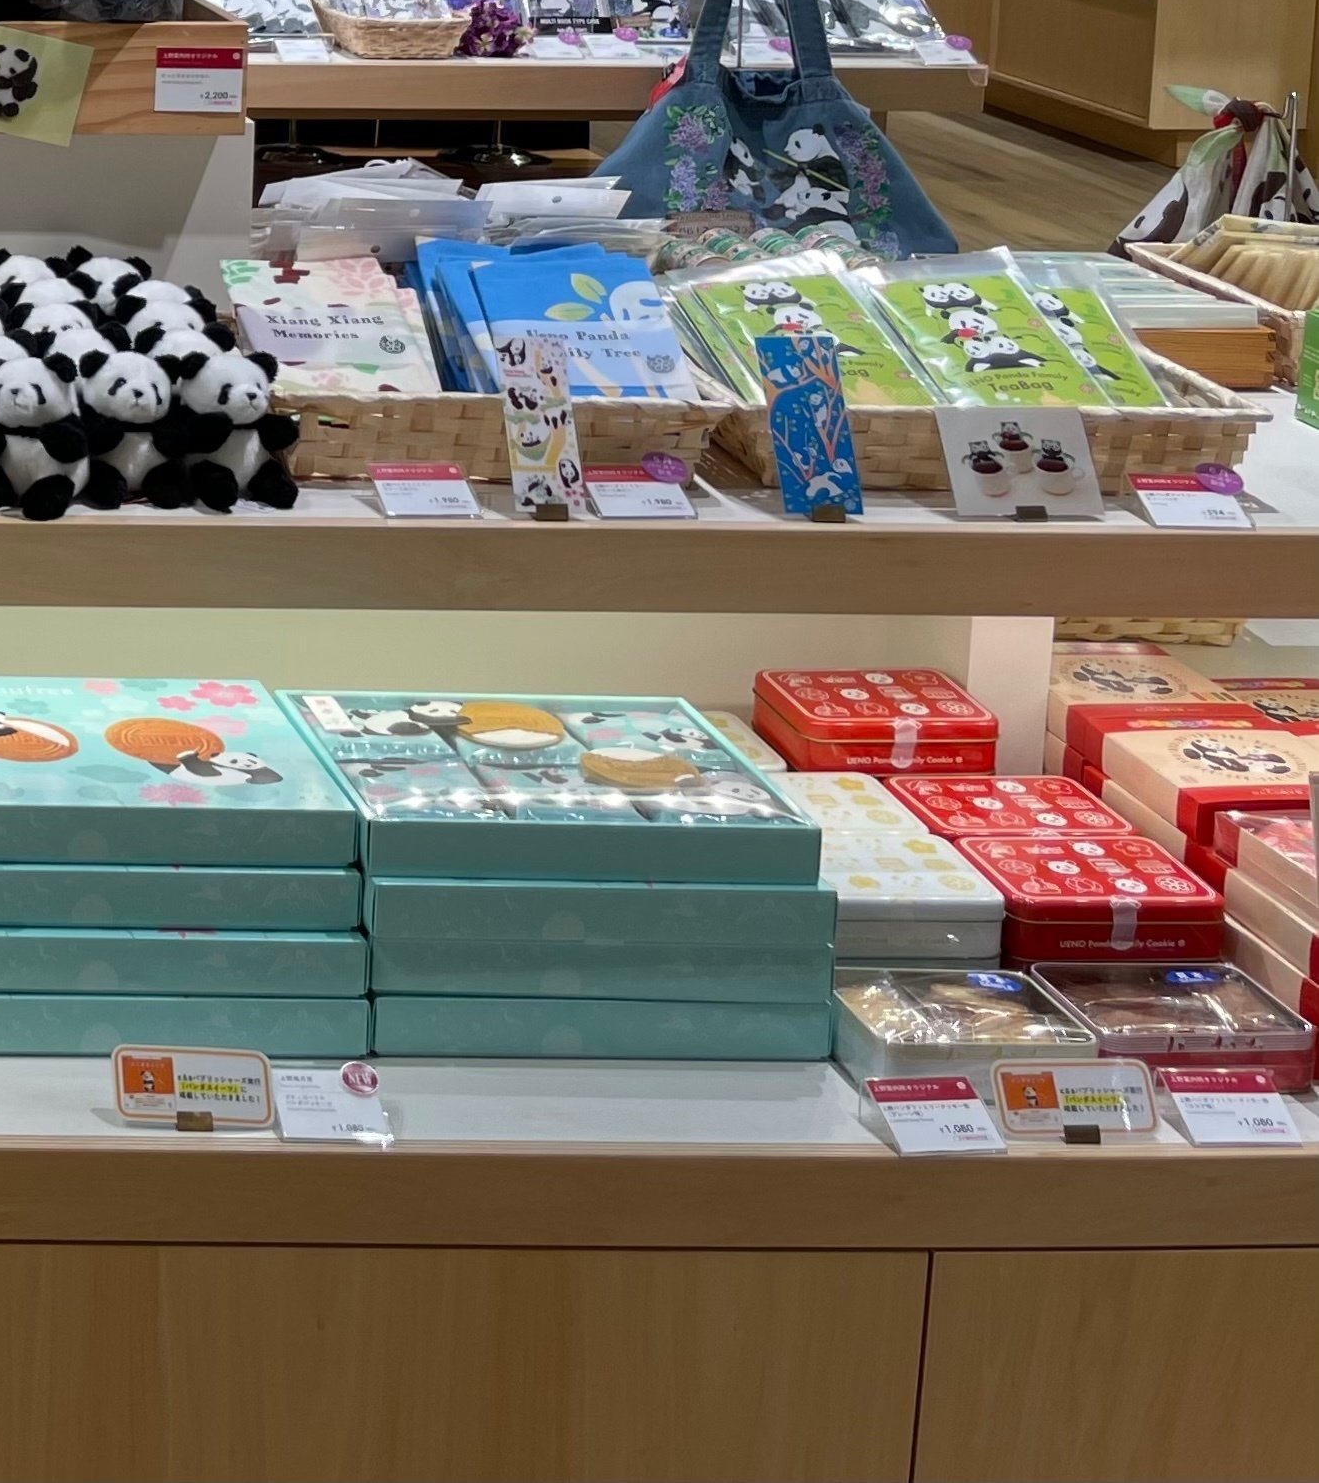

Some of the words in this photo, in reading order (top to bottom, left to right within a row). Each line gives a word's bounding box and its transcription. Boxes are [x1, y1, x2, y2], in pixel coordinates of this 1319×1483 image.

[265, 314, 322, 327] Xiang
[326, 314, 384, 326] Xiang
[271, 328, 360, 339] Memories
[576, 329, 631, 341] Panda
[602, 348, 642, 358] Tree
[996, 372, 1027, 381] Panda
[1030, 371, 1068, 381] Family
[987, 380, 1054, 392] TeaBag
[348, 1071, 372, 1086] NEW
[1237, 1117, 1274, 1127] ¥1,080
[939, 1124, 975, 1134] ¥1,080
